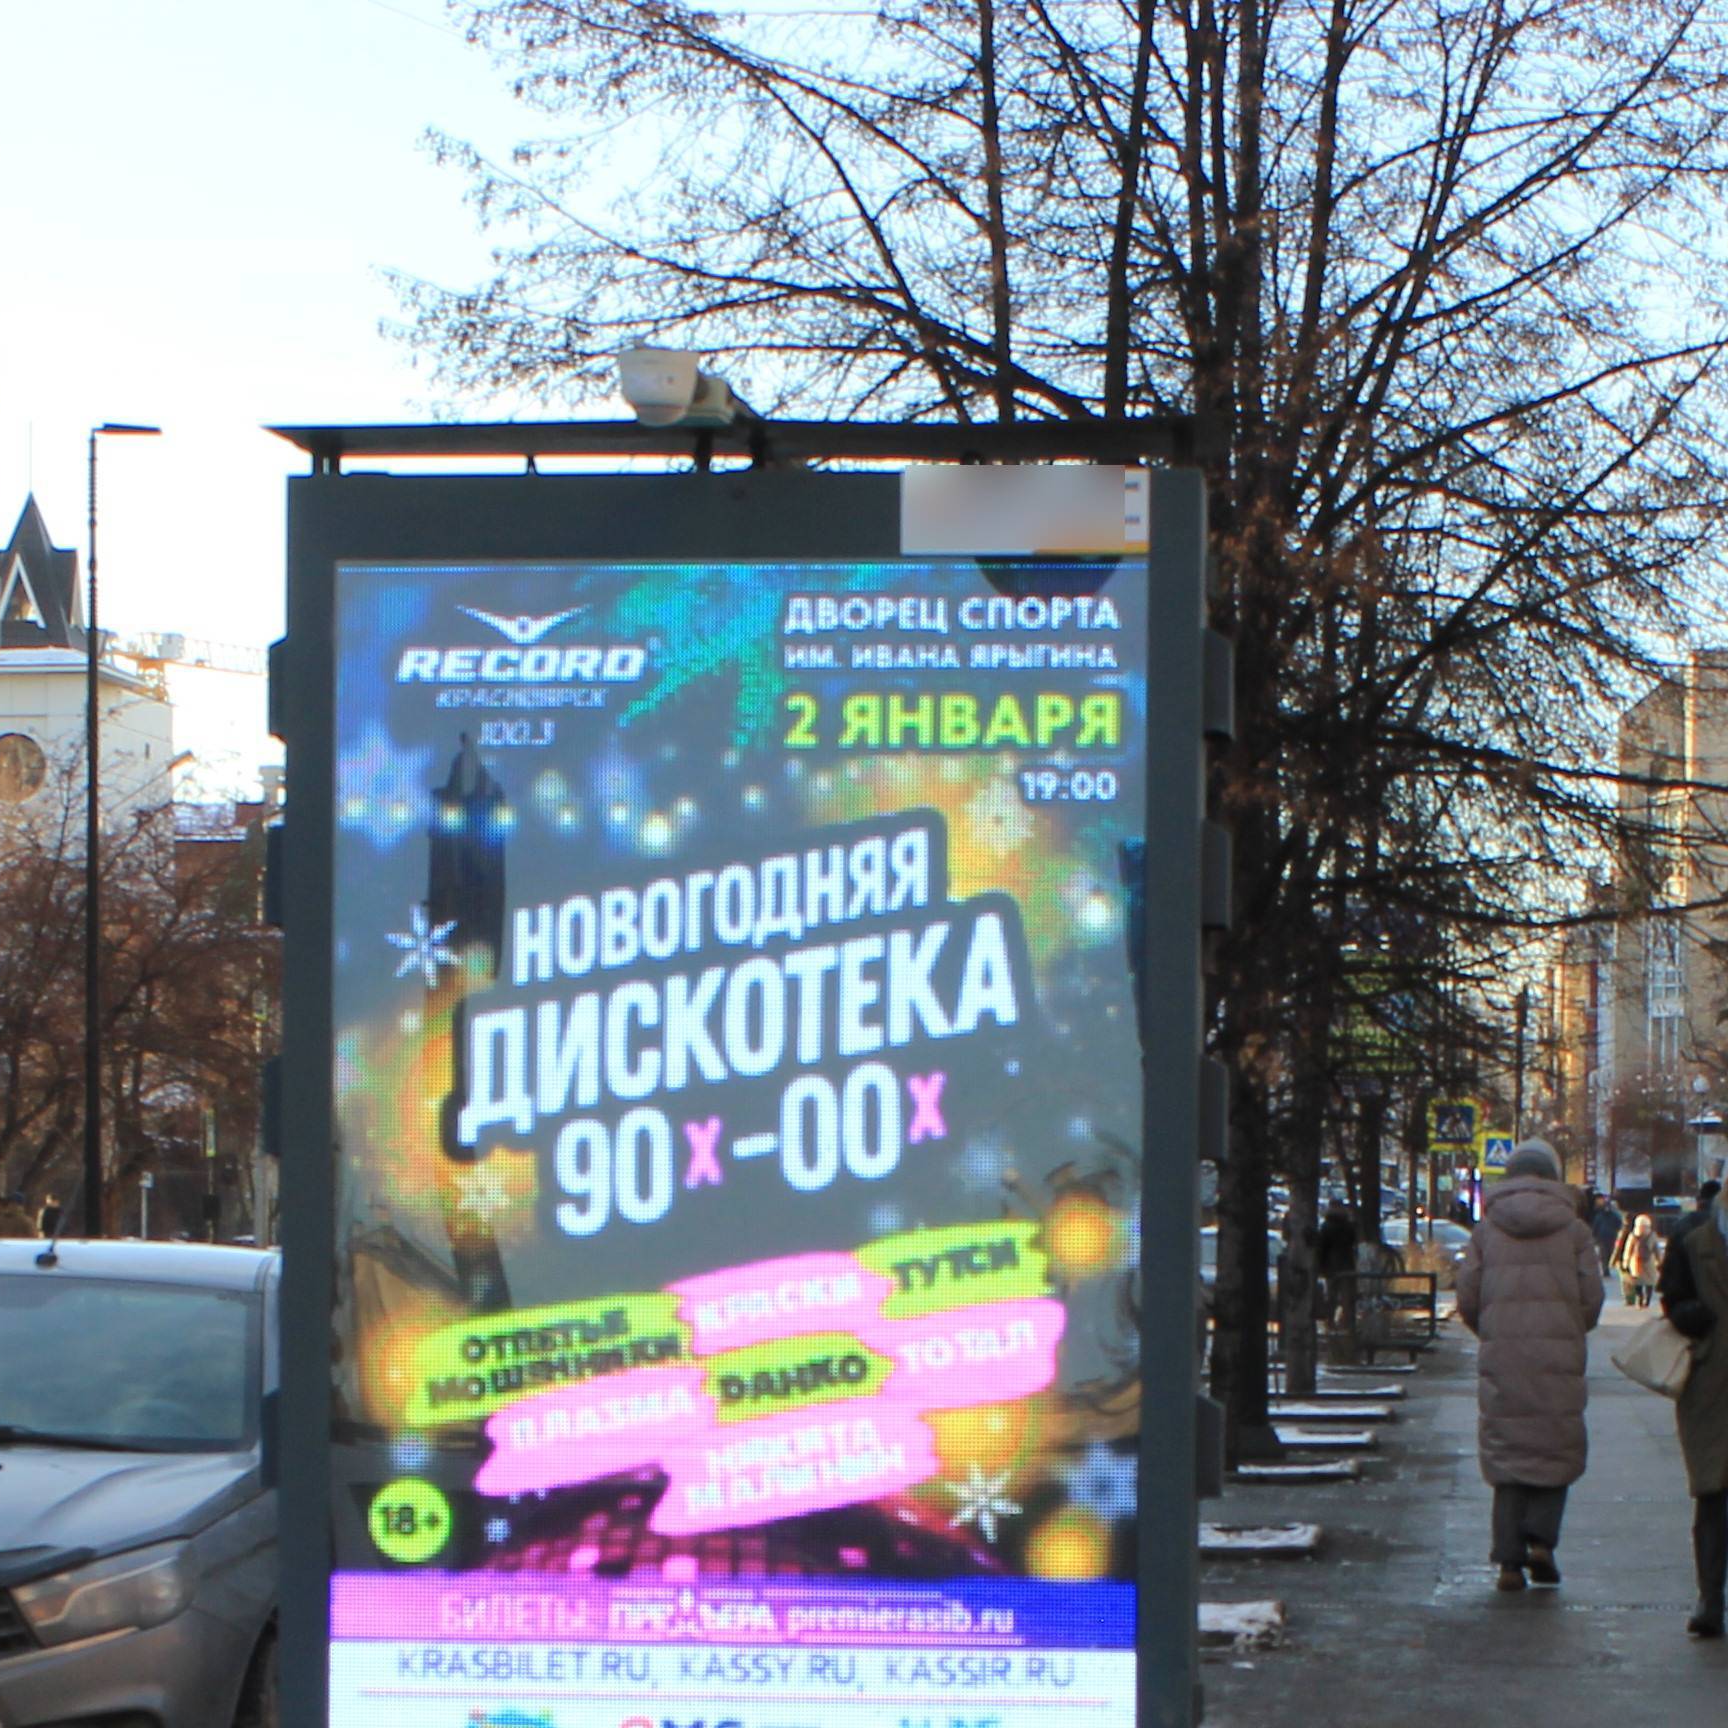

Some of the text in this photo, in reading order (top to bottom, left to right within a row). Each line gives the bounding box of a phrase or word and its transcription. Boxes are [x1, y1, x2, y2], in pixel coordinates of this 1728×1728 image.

[783, 596, 1121, 635] ДВОРЕЦ СПОРТА
[395, 646, 649, 684] RECORD
[851, 644, 960, 670] ИВАНА
[970, 644, 1119, 670] ЯРЫГИНА
[783, 694, 1121, 749] 2 ЯНВАРЯ
[1021, 771, 1118, 801] 19:00
[513, 827, 931, 986] НОВОГОДНЯЯ
[456, 912, 1020, 1147] ДИСКОТЕКА
[893, 1236, 1020, 1292] ТУТСИ
[509, 1384, 697, 1449] ПЛАЗМА
[379, 1504, 443, 1537] 18+
[787, 1597, 1015, 1641] premierasib.ru
